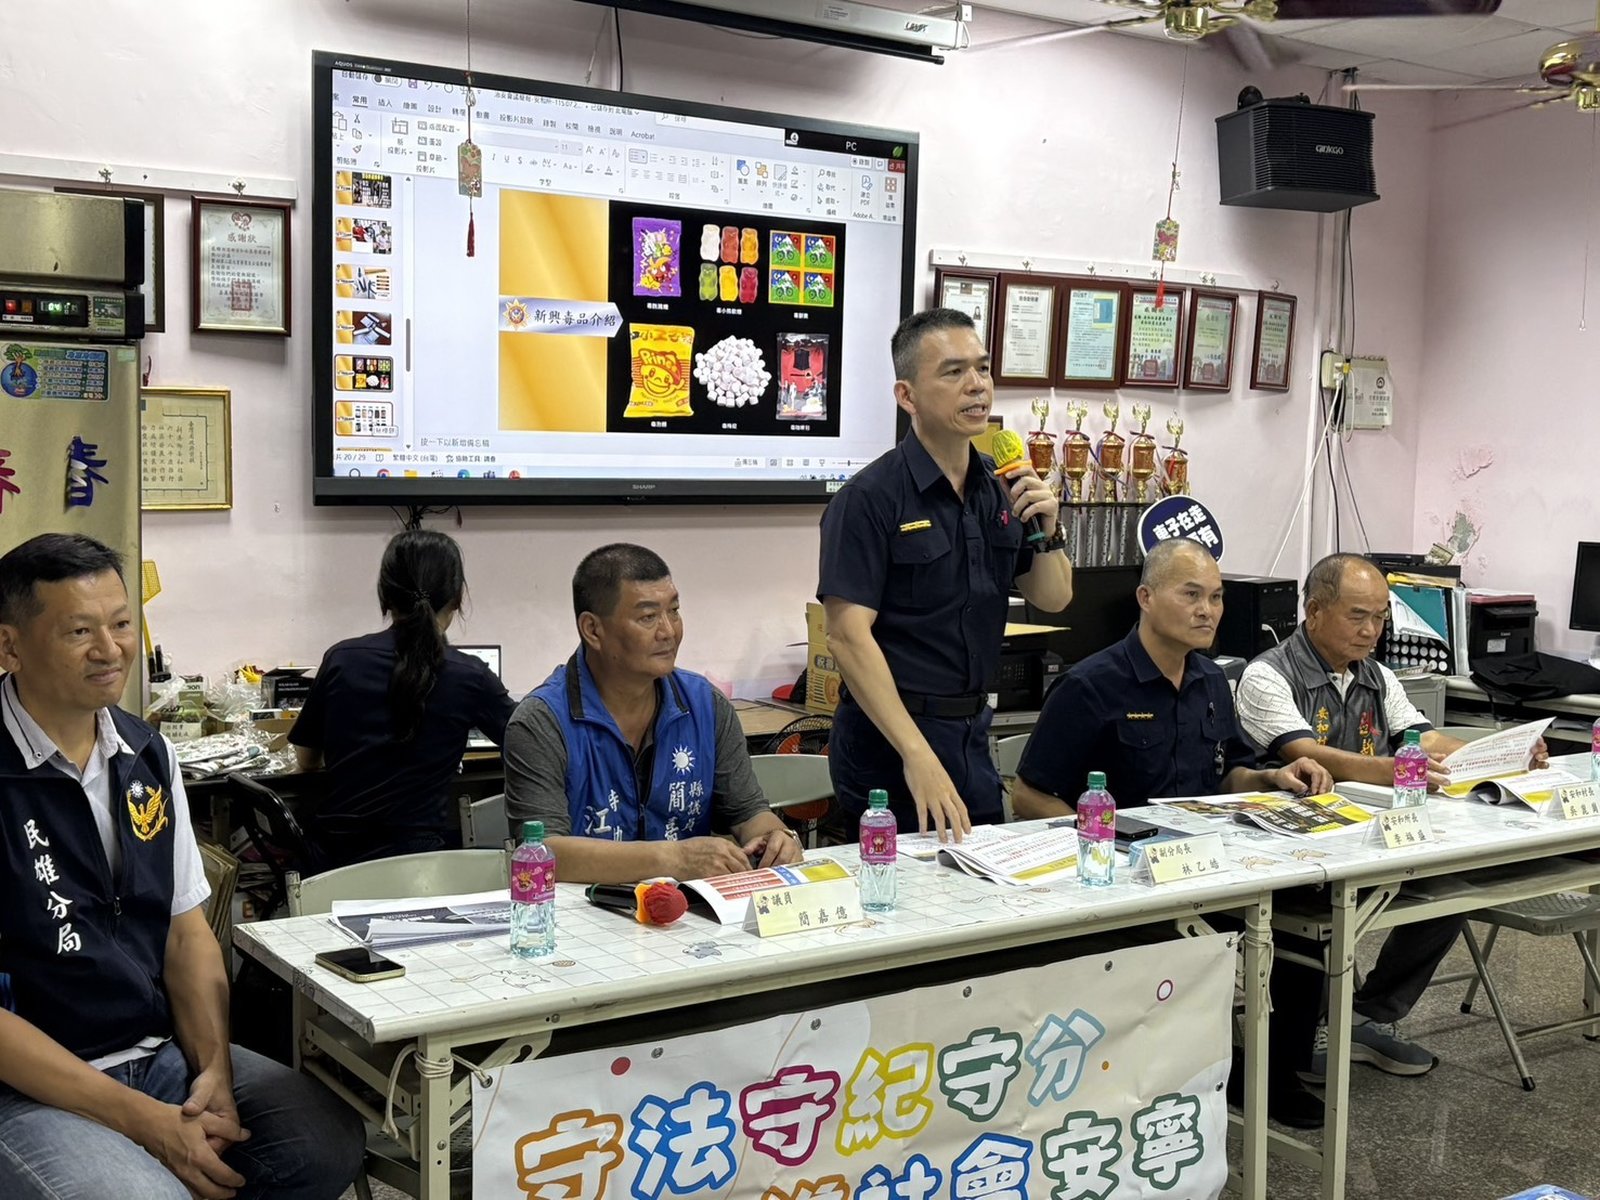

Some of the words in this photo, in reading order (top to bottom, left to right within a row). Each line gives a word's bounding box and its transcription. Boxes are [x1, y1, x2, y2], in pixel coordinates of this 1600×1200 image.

[630, 131, 655, 140] Acrobat
[845, 141, 858, 151] PC
[534, 308, 616, 327] 新興毒品介紹
[1152, 504, 1207, 541] 車子在走
[1159, 842, 1192, 858] 副分局長
[23, 818, 82, 955] 民雄分局
[770, 891, 793, 907] 議員
[798, 906, 849, 927] 簡嘉億
[514, 1008, 1106, 1200] 守法守紀守分
[761, 1093, 1204, 1200] 社會安寧
